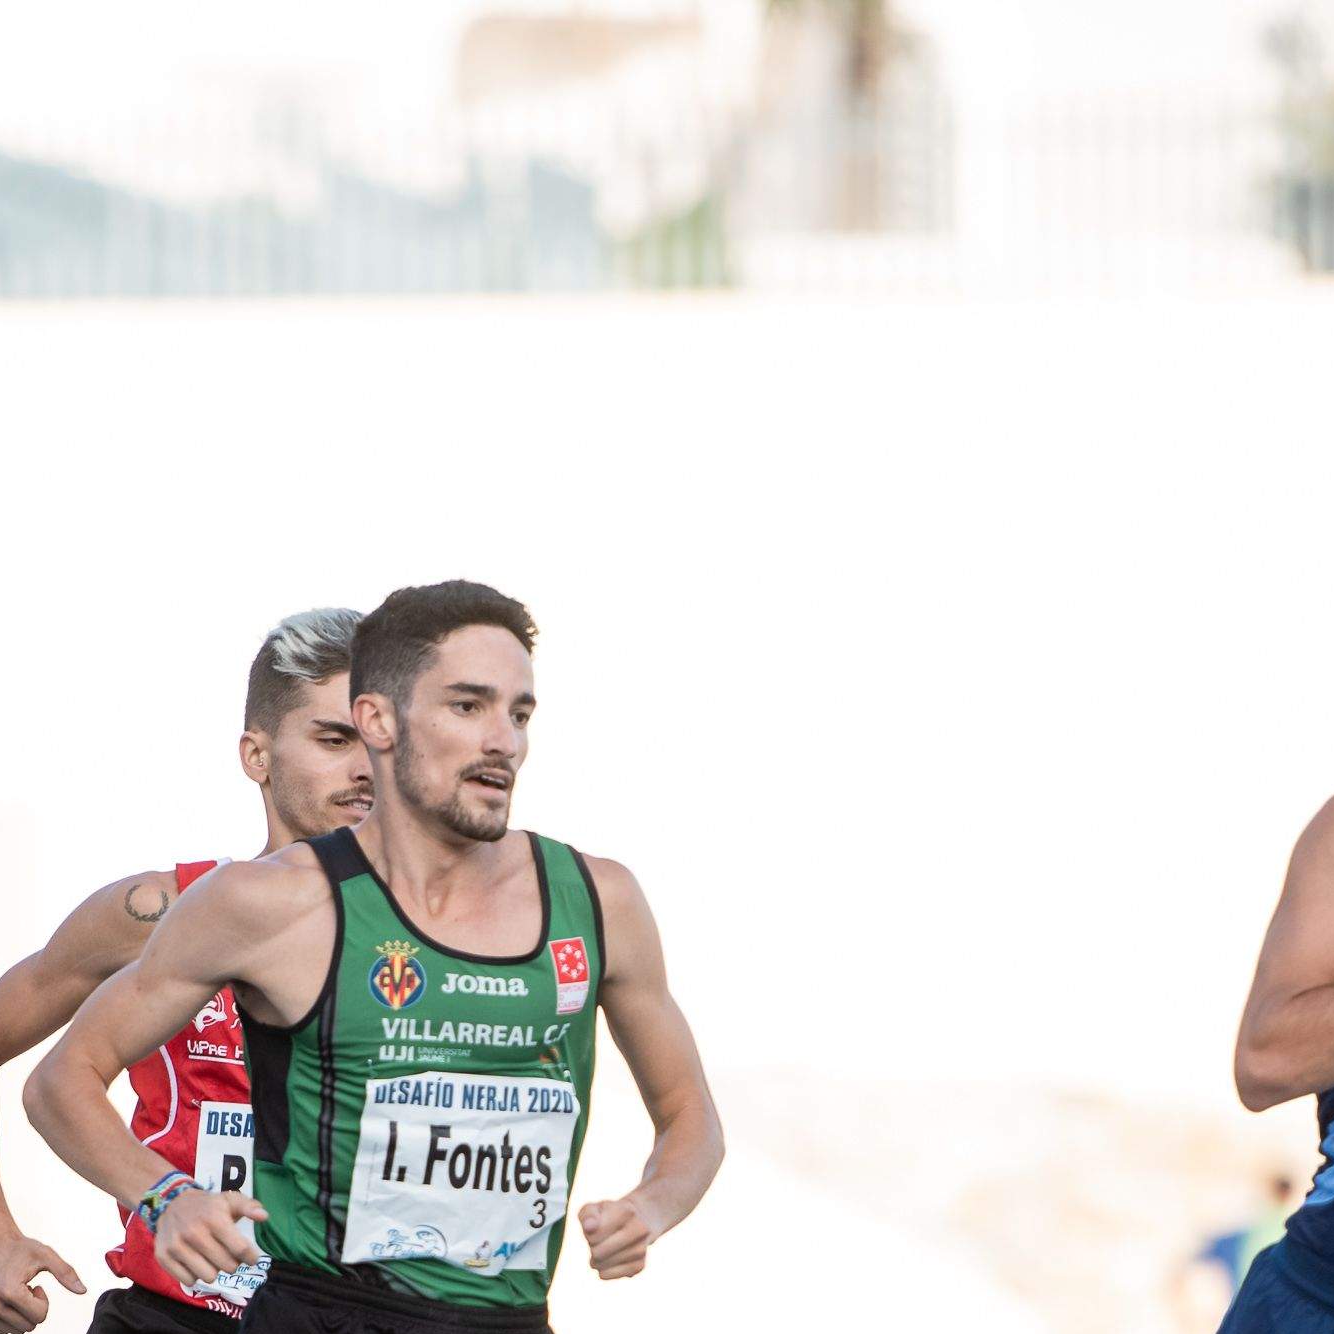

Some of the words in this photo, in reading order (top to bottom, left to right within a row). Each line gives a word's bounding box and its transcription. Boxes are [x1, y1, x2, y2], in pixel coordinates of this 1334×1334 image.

[382, 1017, 537, 1047] VILLARREAL
[379, 1044, 415, 1061] UJI
[375, 1077, 454, 1108] DESAFÍO
[462, 1084, 520, 1112] NERJA
[528, 1087, 574, 1114] 2020
[382, 1120, 407, 1182] I.
[422, 1124, 552, 1194] Fontes
[529, 1198, 547, 1229] 3
